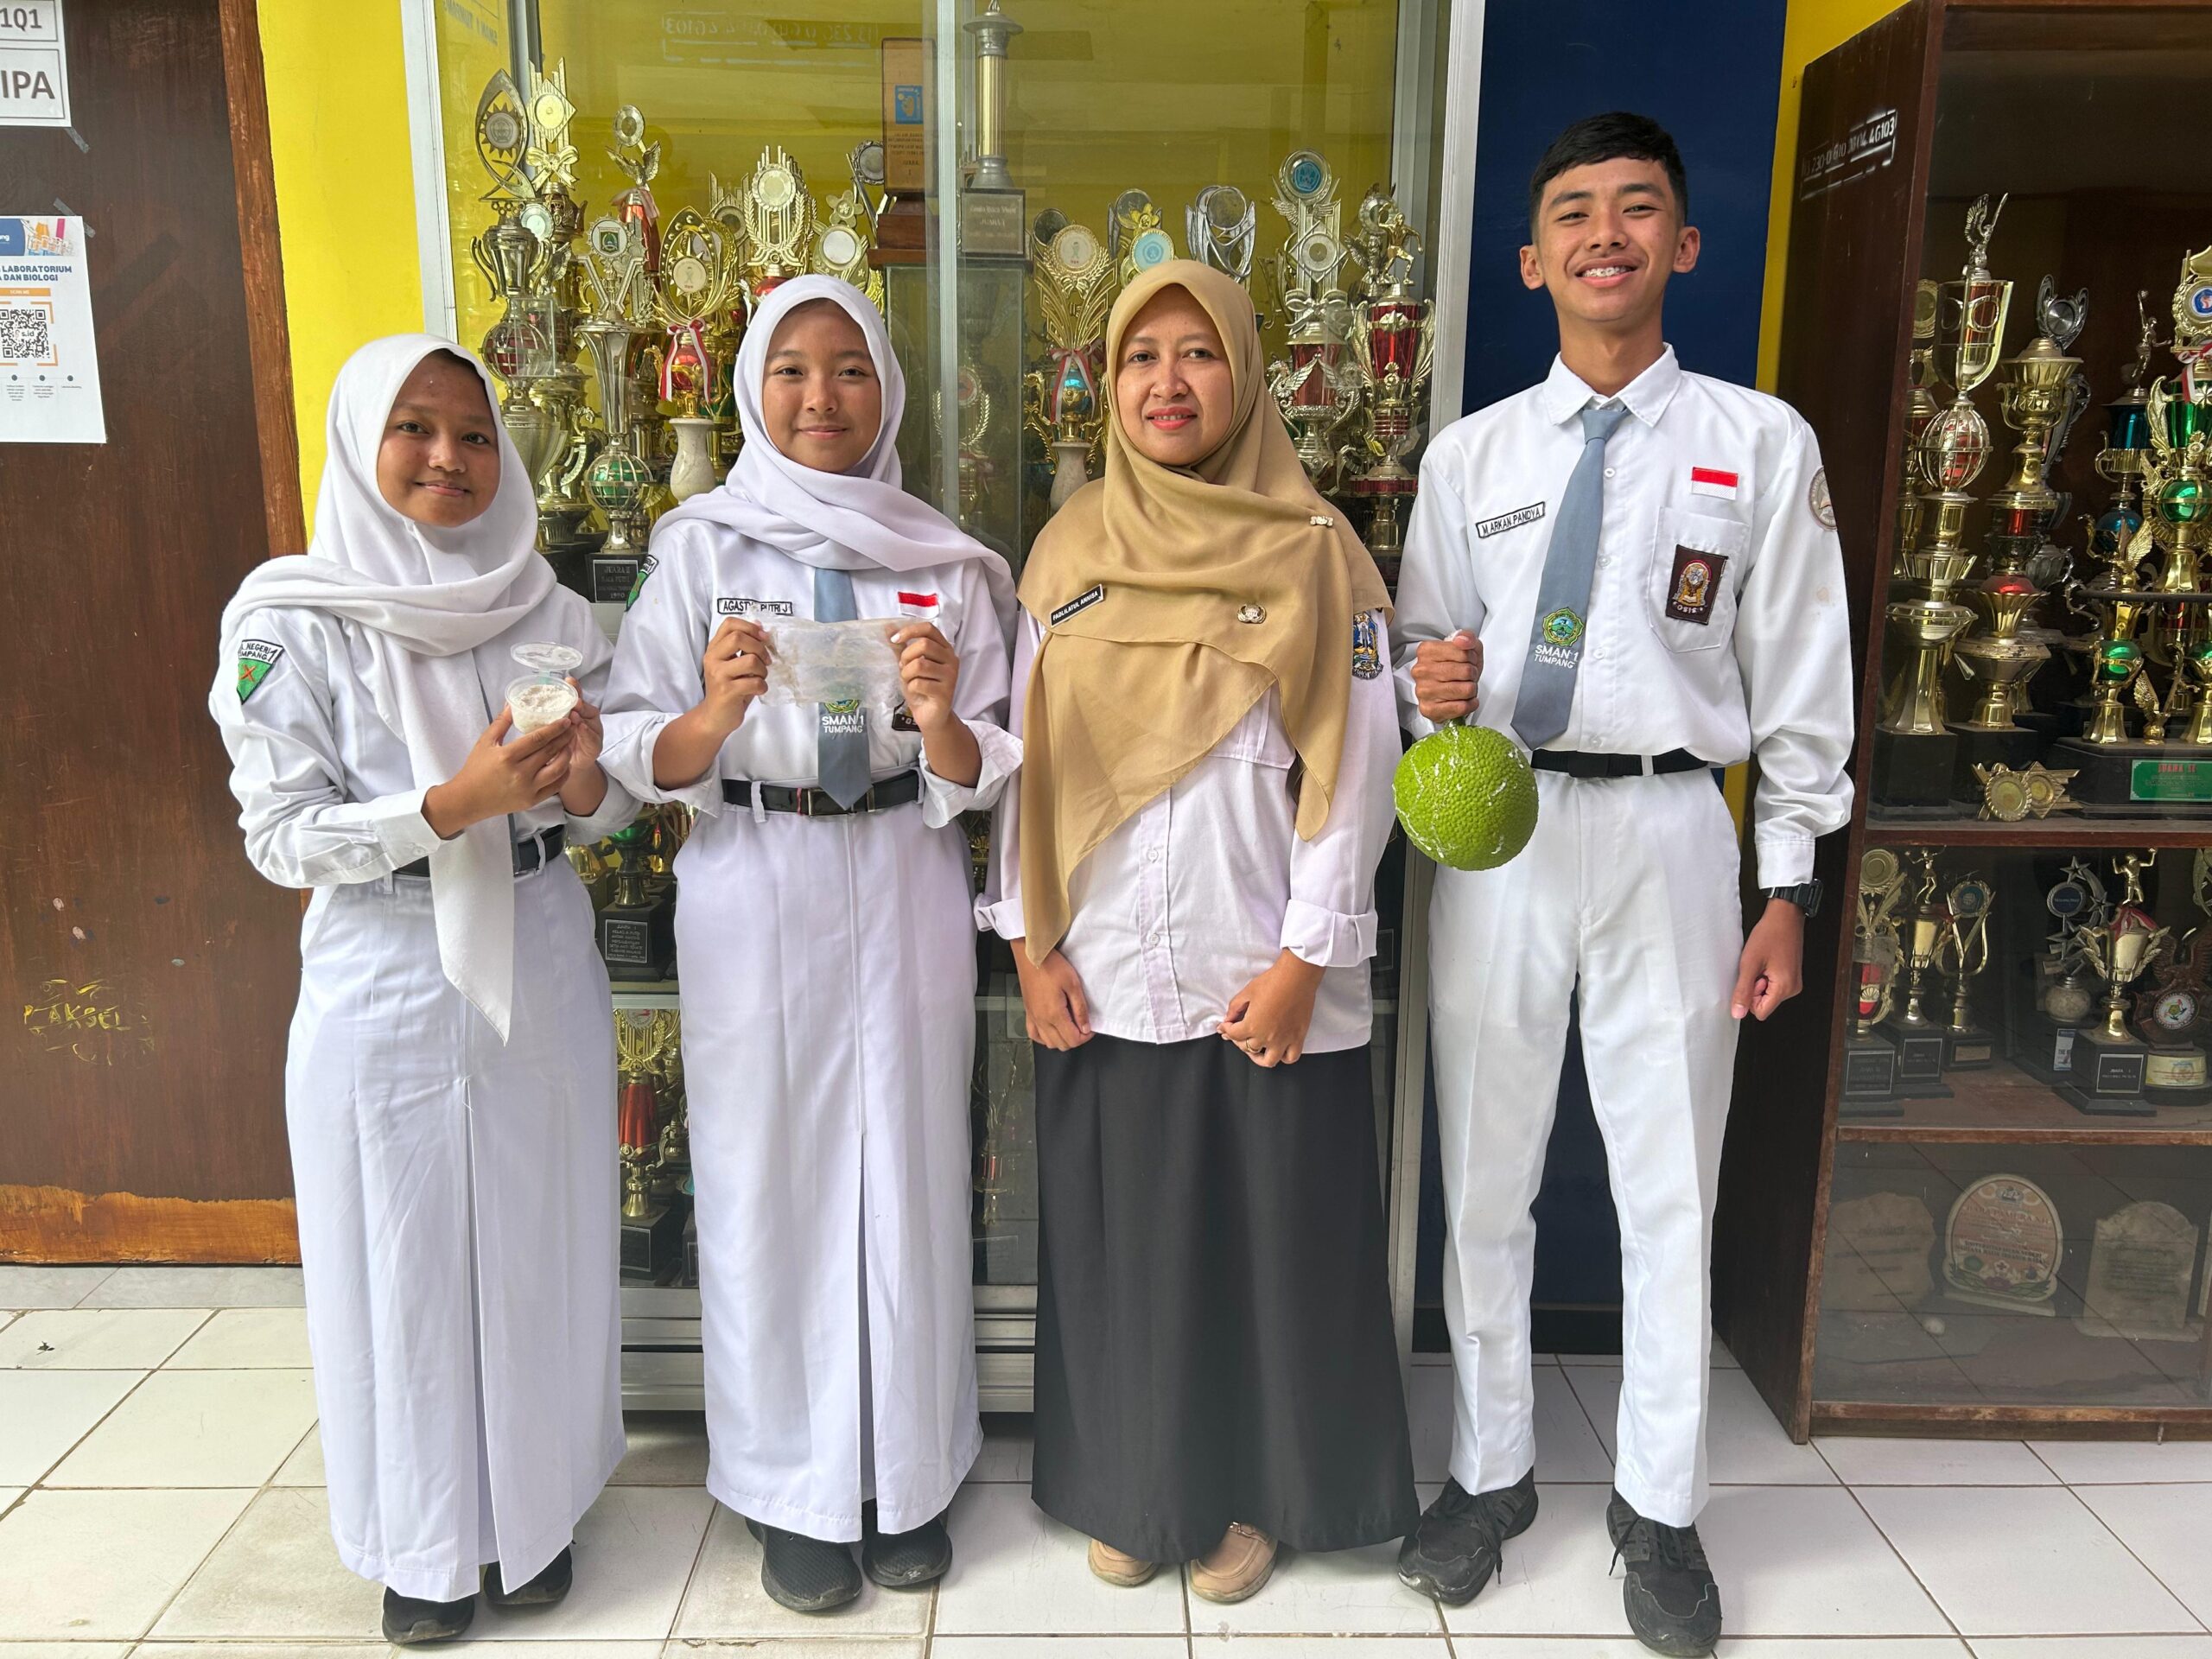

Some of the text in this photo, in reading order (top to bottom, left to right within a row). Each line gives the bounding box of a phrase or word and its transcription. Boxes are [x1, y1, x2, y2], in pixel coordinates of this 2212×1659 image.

[1, 70, 55, 99] IPA
[1490, 515, 1512, 533] ARKAN
[1512, 506, 1541, 525] PANDYA
[1080, 590, 1098, 606] ANNISA
[1676, 604, 1698, 613] OSIS
[1534, 653, 1576, 670] TUMPANG
[1535, 644, 1580, 664] SMAN 1
[821, 715, 865, 726] SMAN 1
[823, 725, 863, 734] TUMPANG
